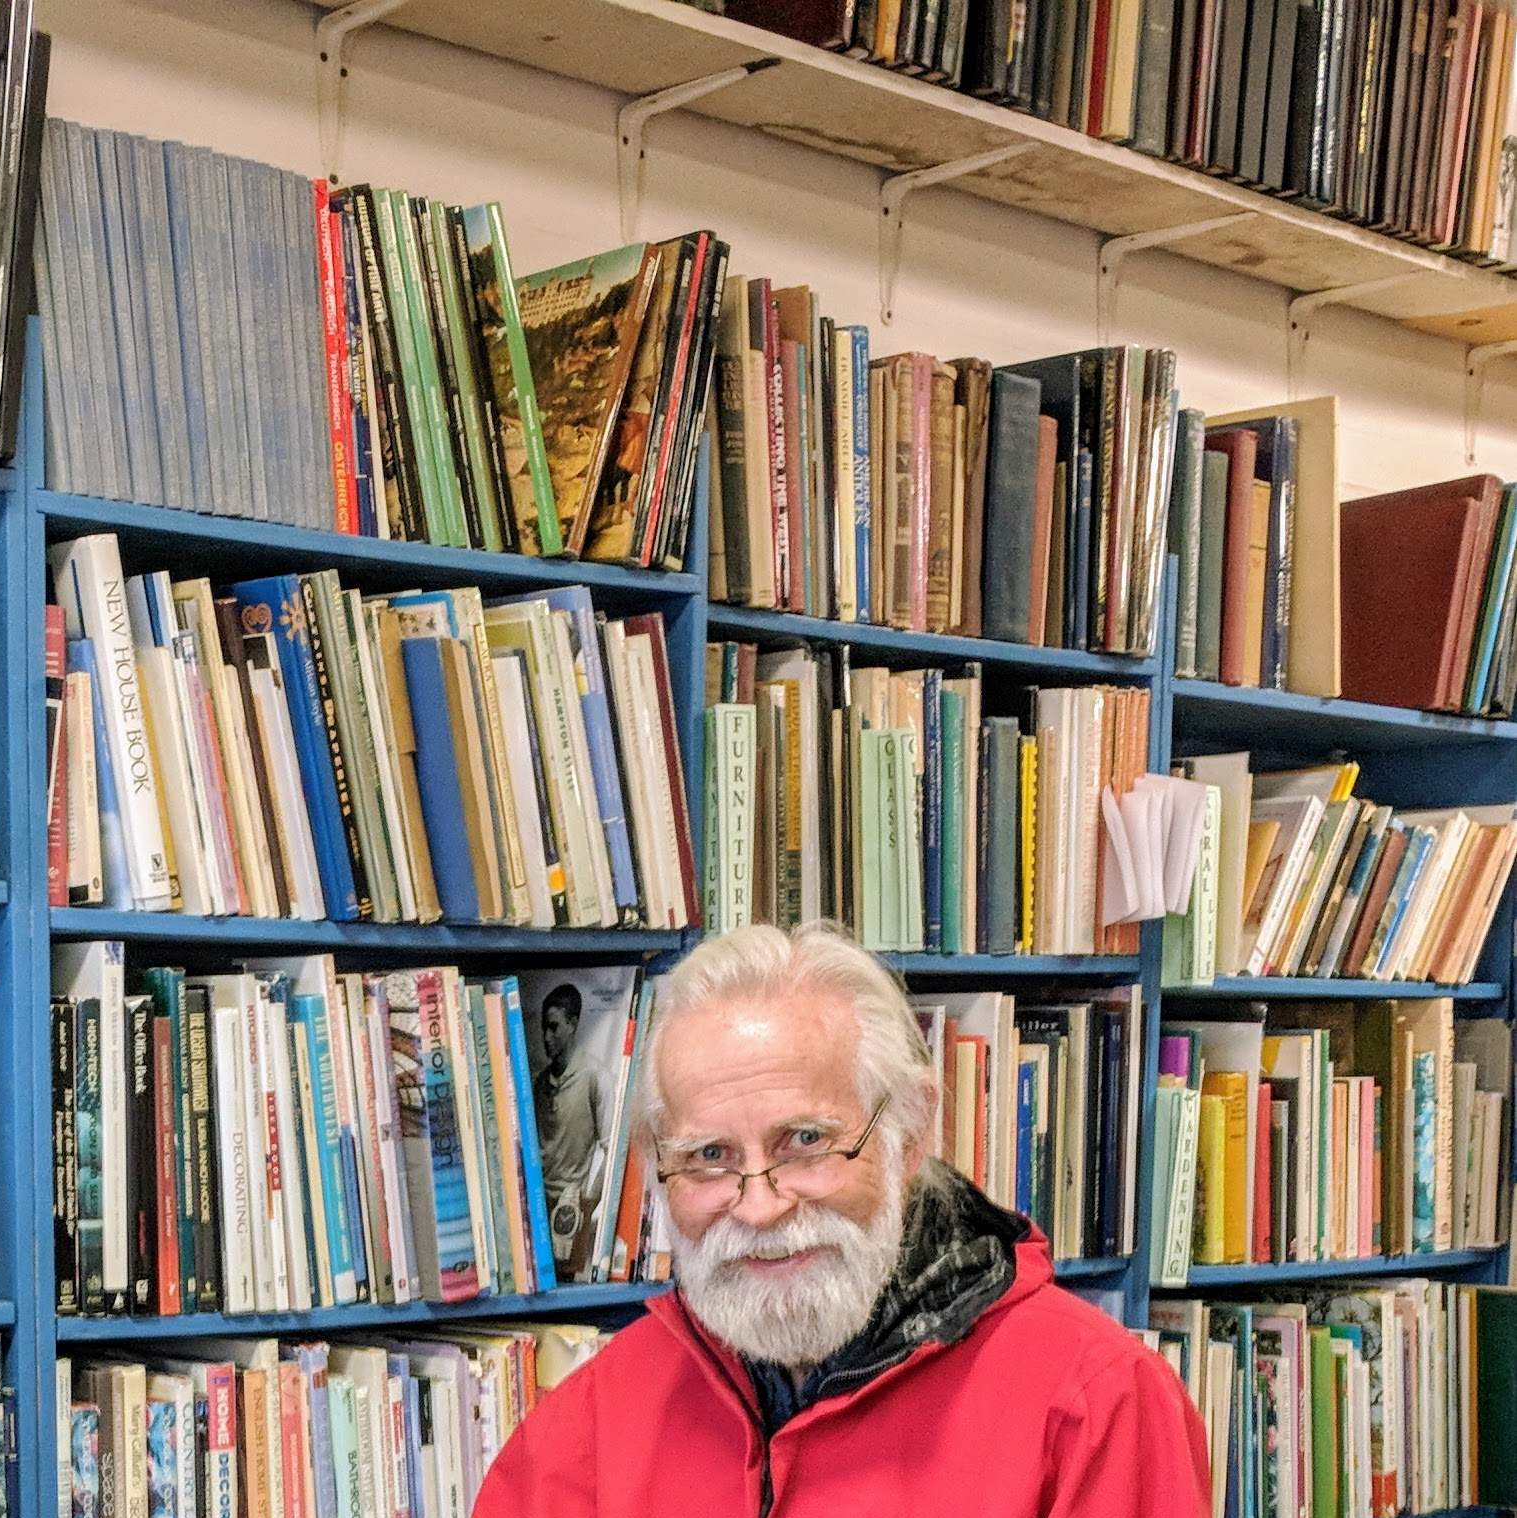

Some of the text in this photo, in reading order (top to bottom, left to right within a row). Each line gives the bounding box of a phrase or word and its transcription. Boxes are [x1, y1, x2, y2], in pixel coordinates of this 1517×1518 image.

[772, 364, 785, 469] COLLECTING
[102, 579, 150, 795] NEW HOUSE BOOK
[302, 658, 322, 726] African Style
[85, 1018, 98, 1093] HIGH-TECH
[133, 1033, 146, 1063] Office
[423, 993, 454, 1168] Interior Design
[230, 1132, 248, 1234] DECORATING
[179, 1402, 194, 1499] COUNTRY
[214, 1388, 229, 1446] HOME
